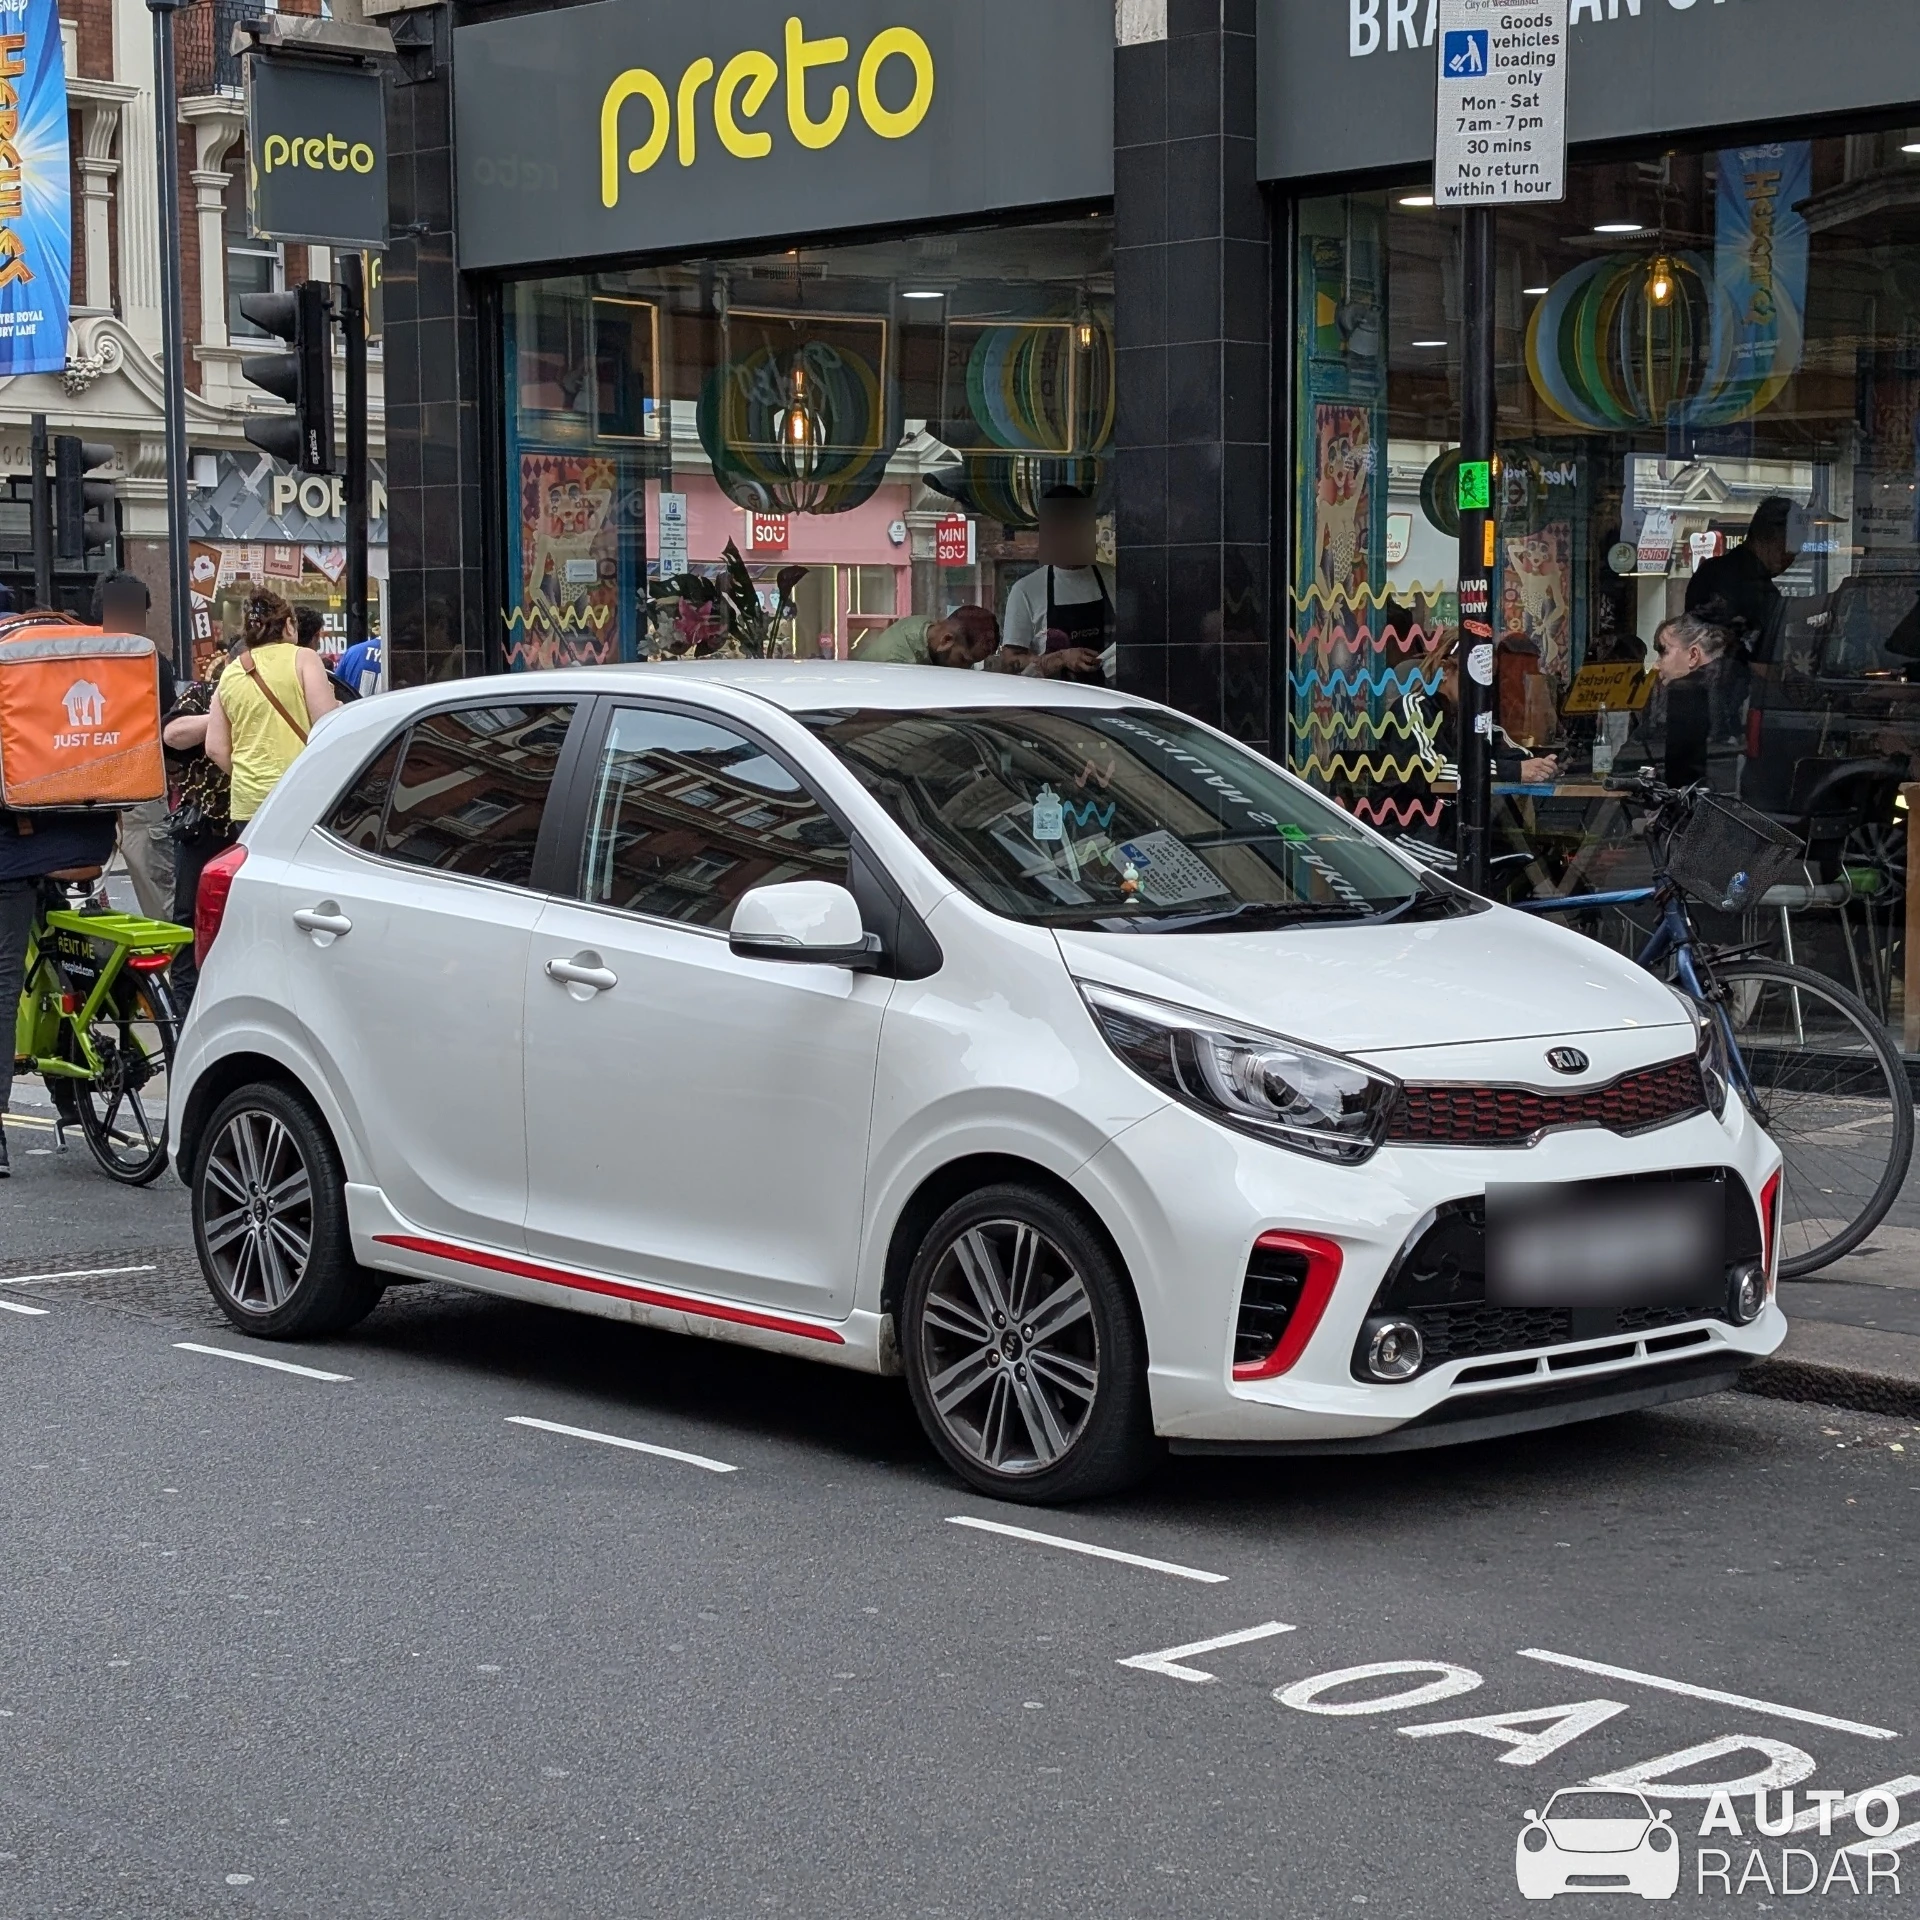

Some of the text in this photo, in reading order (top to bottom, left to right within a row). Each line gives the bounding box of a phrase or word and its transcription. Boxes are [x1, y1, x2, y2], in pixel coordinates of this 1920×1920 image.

[1501, 13, 1553, 29] Goods
[1493, 32, 1559, 48] vehicles
[1496, 52, 1556, 67] loading
[1508, 70, 1542, 86] only
[1462, 97, 1496, 111] Mon
[1510, 93, 1539, 108] Sat
[601, 16, 934, 208] preto
[264, 133, 374, 174] preto
[1467, 138, 1531, 154] 30 mins
[1459, 162, 1538, 177] No return
[1445, 180, 1551, 197] within 1 hour
[17, 310, 44, 322] ROYAL
[16, 324, 36, 336] LANE
[939, 528, 965, 542] MINI
[1638, 549, 1667, 560] DENTIST
[1460, 579, 1488, 592] VIVA
[1461, 602, 1487, 613] TONY
[54, 732, 120, 749] JUST EAT
[81, 941, 96, 960] ME
[1551, 1050, 1586, 1068] KIA
